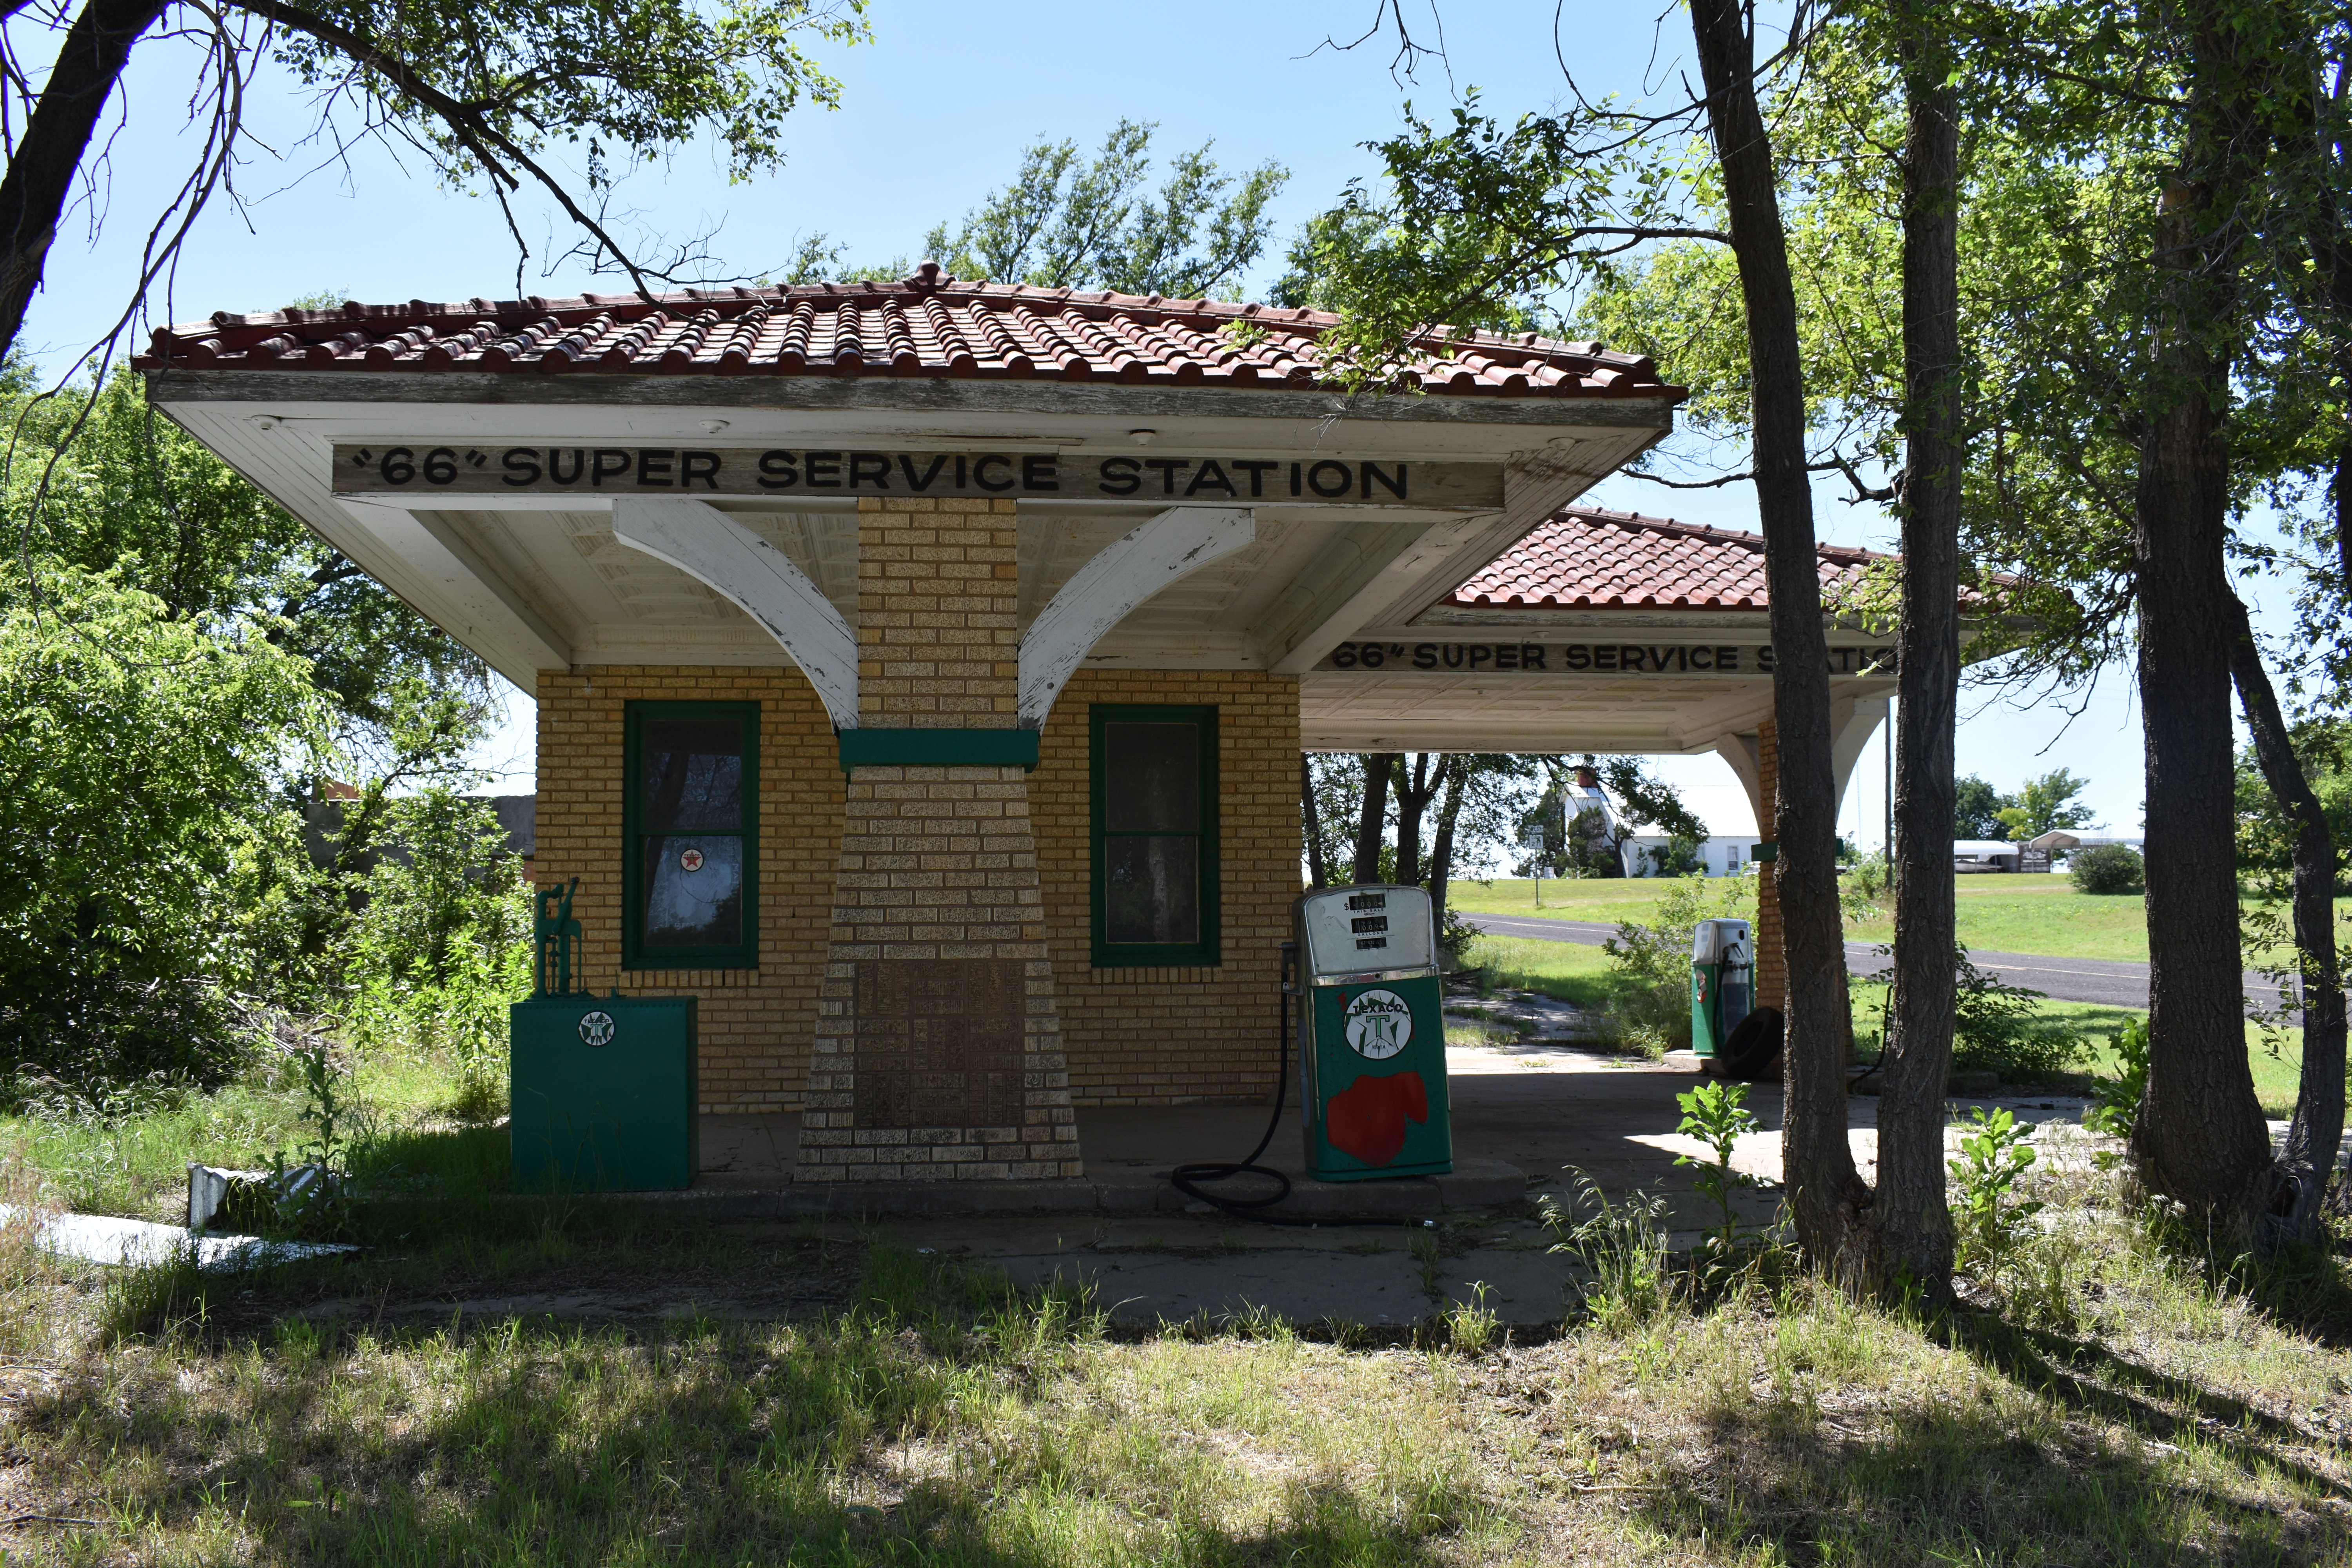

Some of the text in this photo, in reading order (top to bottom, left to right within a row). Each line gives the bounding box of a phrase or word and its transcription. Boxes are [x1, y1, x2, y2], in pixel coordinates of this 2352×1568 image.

[352, 446, 1408, 500] "66" SUPER SERVICE STATION
[1412, 643, 1546, 670] SUPER
[1566, 645, 1738, 671] SERVICE
[1757, 645, 1898, 672] STIO
[1353, 1004, 1402, 1014] TEXACO
